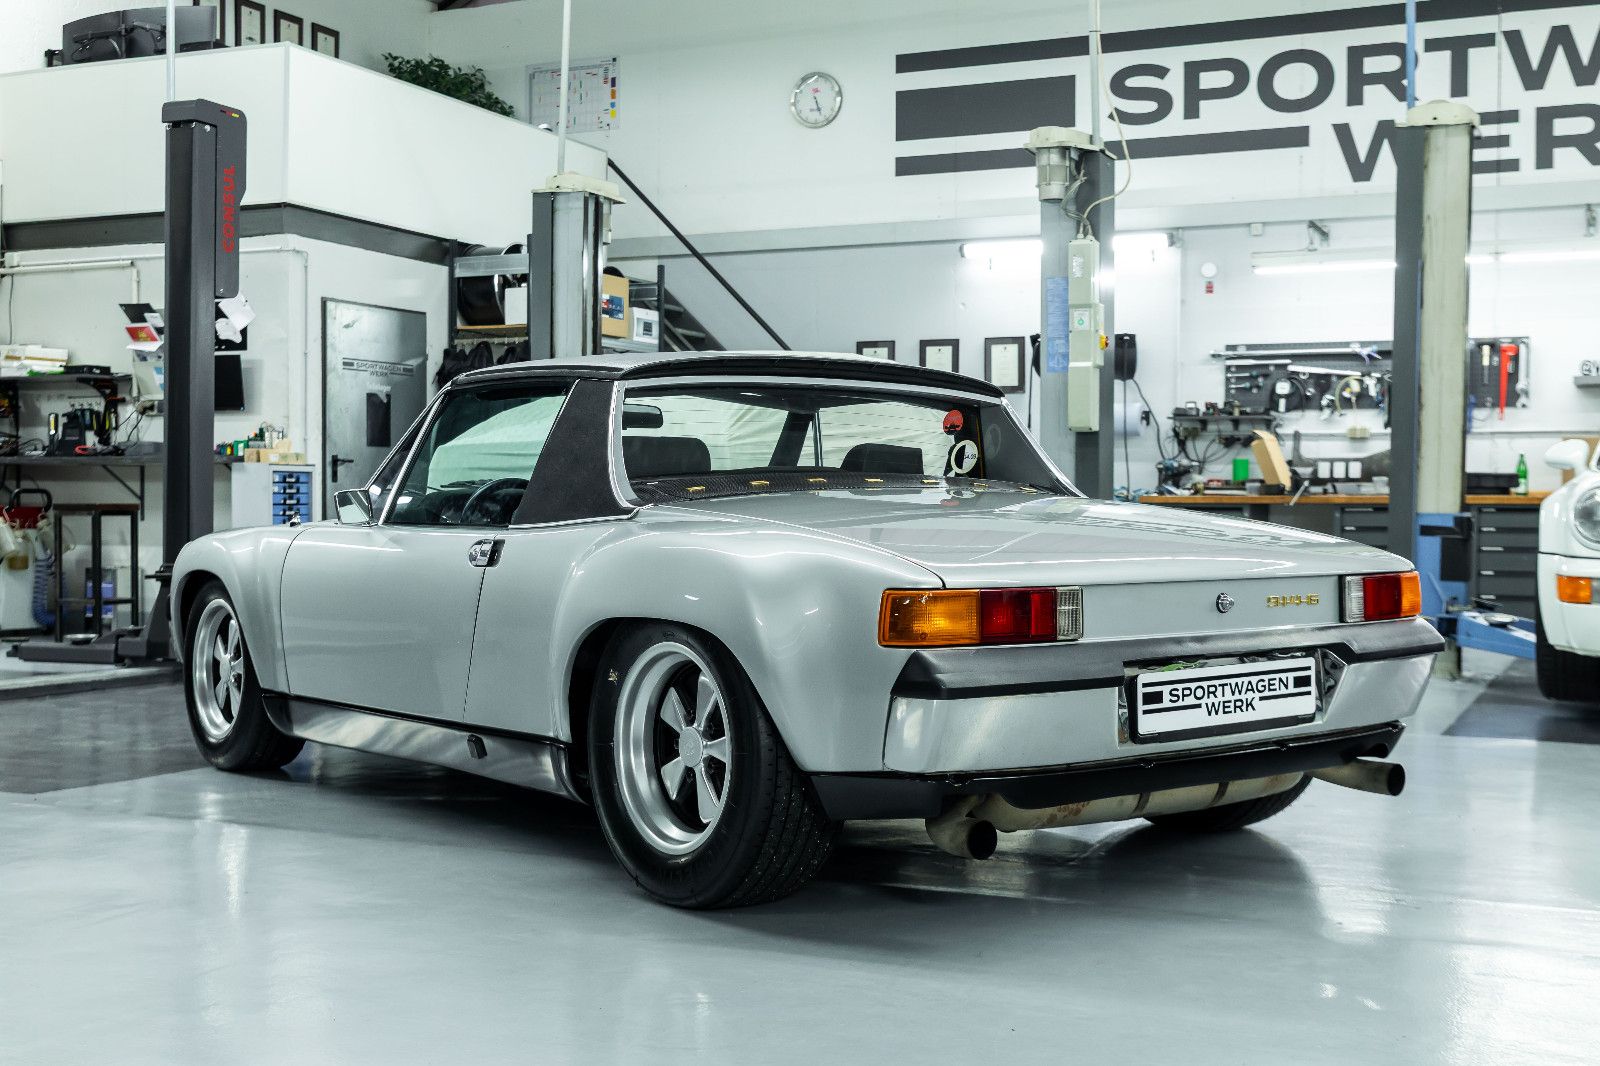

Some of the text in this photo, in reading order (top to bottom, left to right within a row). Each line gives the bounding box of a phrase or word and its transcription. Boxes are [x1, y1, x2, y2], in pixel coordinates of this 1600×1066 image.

[223, 164, 236, 253] CONSUL
[356, 362, 402, 372] SPORTWAGEN
[1168, 676, 1289, 703] SPORTWAGEN
[1205, 696, 1256, 717] WERK
